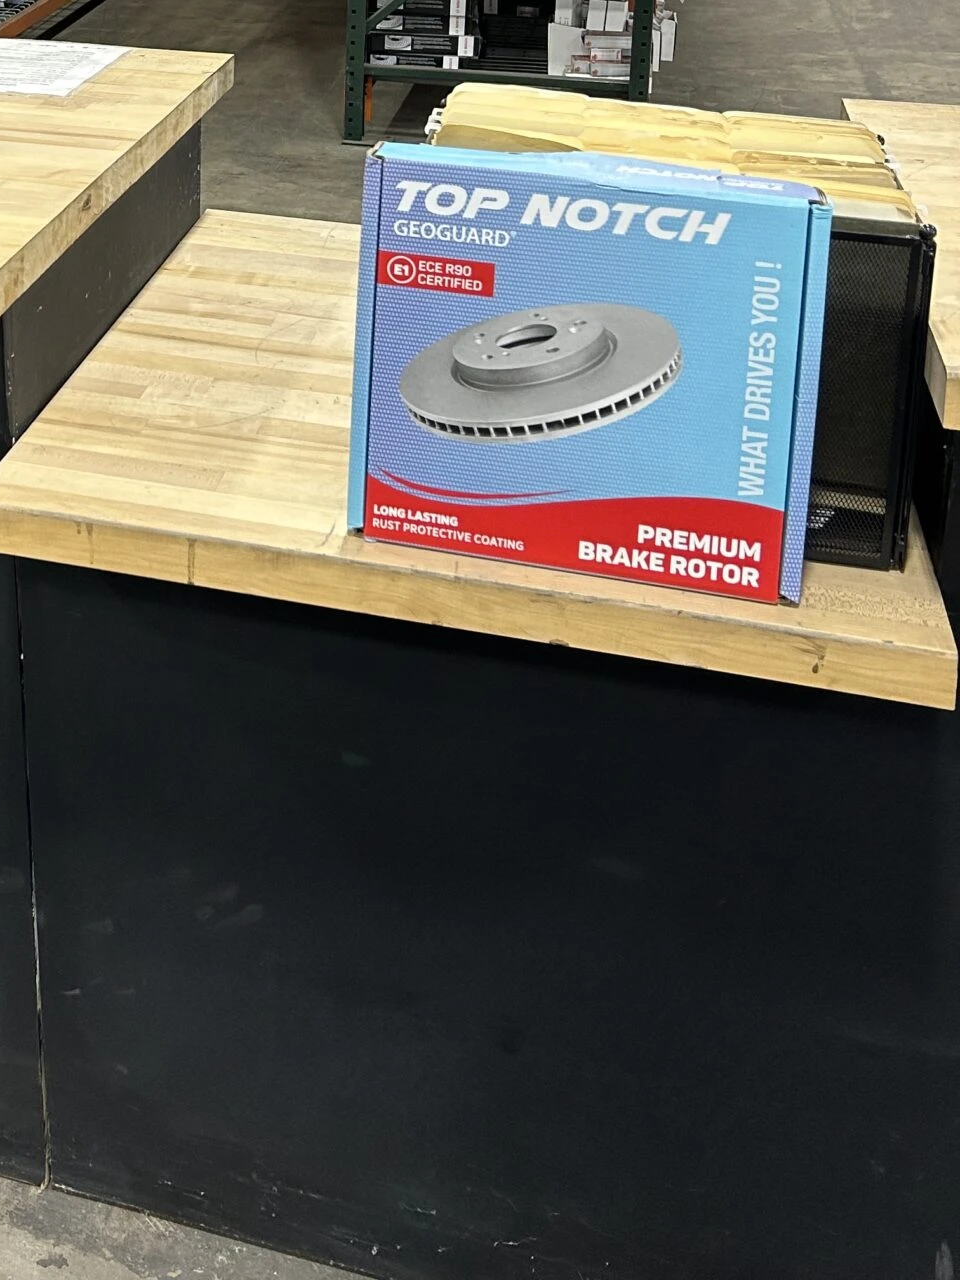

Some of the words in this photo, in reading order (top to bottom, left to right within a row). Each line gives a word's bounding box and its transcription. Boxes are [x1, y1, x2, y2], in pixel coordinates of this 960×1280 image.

[394, 179, 510, 219] TOP
[519, 194, 732, 245] NOTCH
[394, 219, 510, 247] GEOGUARD
[394, 264, 410, 277] E1
[417, 274, 483, 292] CERTIFIED
[418, 260, 444, 275] ECE
[446, 263, 472, 277] R90
[751, 275, 782, 326] YOU
[743, 331, 777, 421] DRIVES
[737, 425, 769, 497] WHAT
[373, 504, 406, 519] LONG
[407, 508, 459, 527] LASTING
[372, 518, 396, 532] RUST
[397, 521, 473, 545] PROTECTIVE
[473, 533, 525, 551] COATING
[637, 523, 762, 562] PREMIUM
[578, 539, 665, 574] BRAKE
[669, 553, 760, 587] ROTOR
